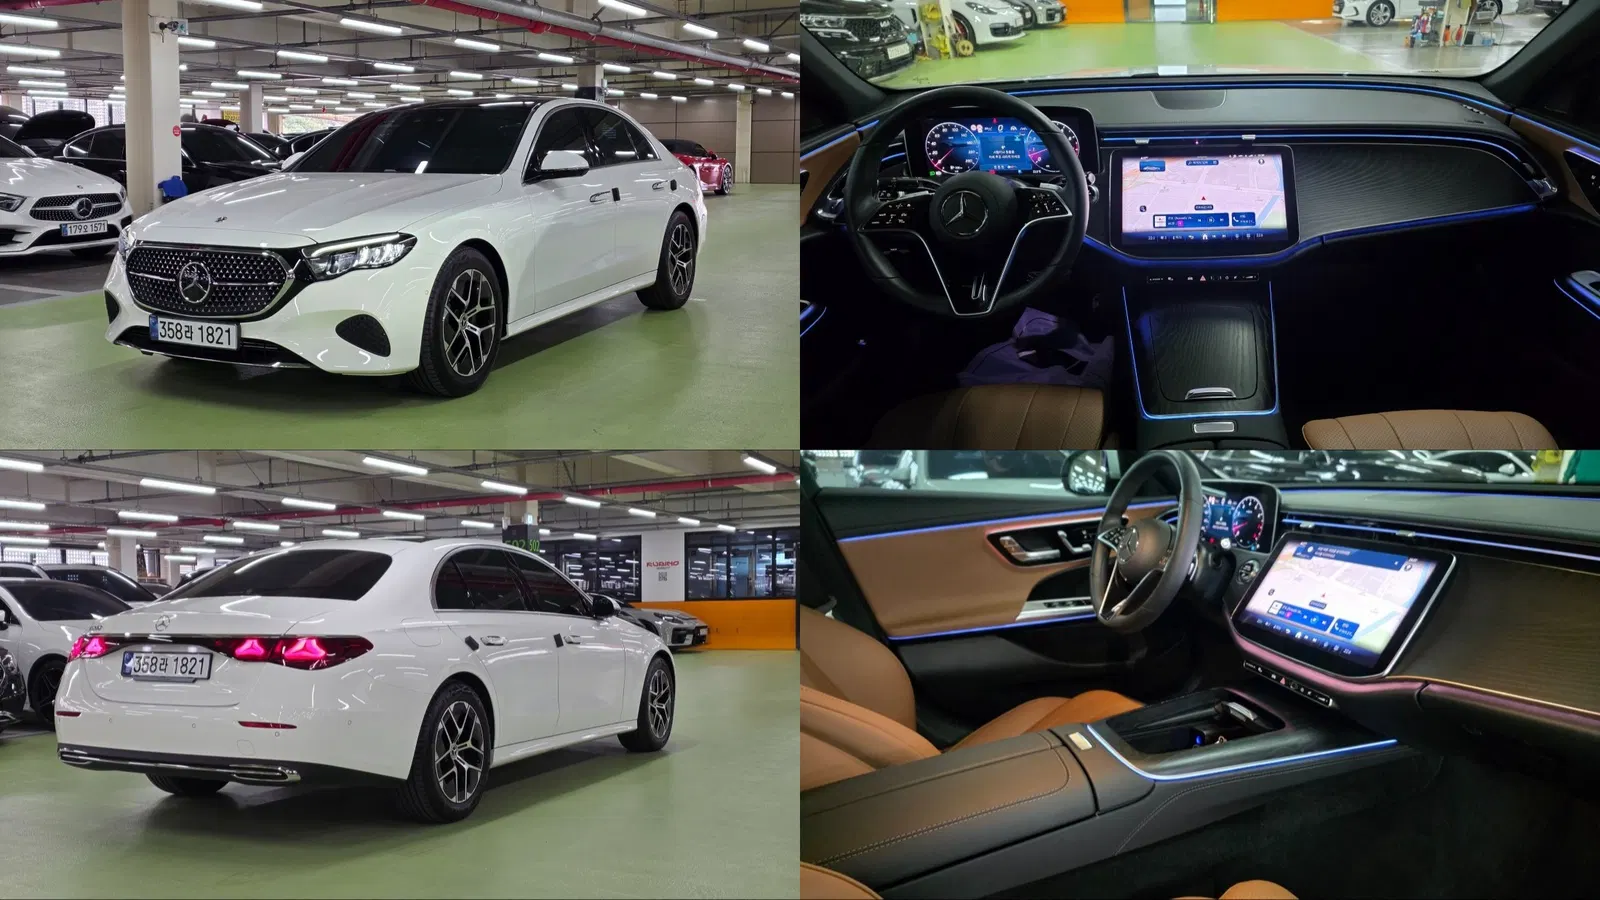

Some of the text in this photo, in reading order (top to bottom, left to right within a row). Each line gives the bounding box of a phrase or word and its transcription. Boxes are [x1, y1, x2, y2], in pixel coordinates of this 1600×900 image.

[69, 222, 106, 234] 179오 1571
[159, 320, 231, 346] 358라 1821
[133, 656, 205, 675] 358라 1821
